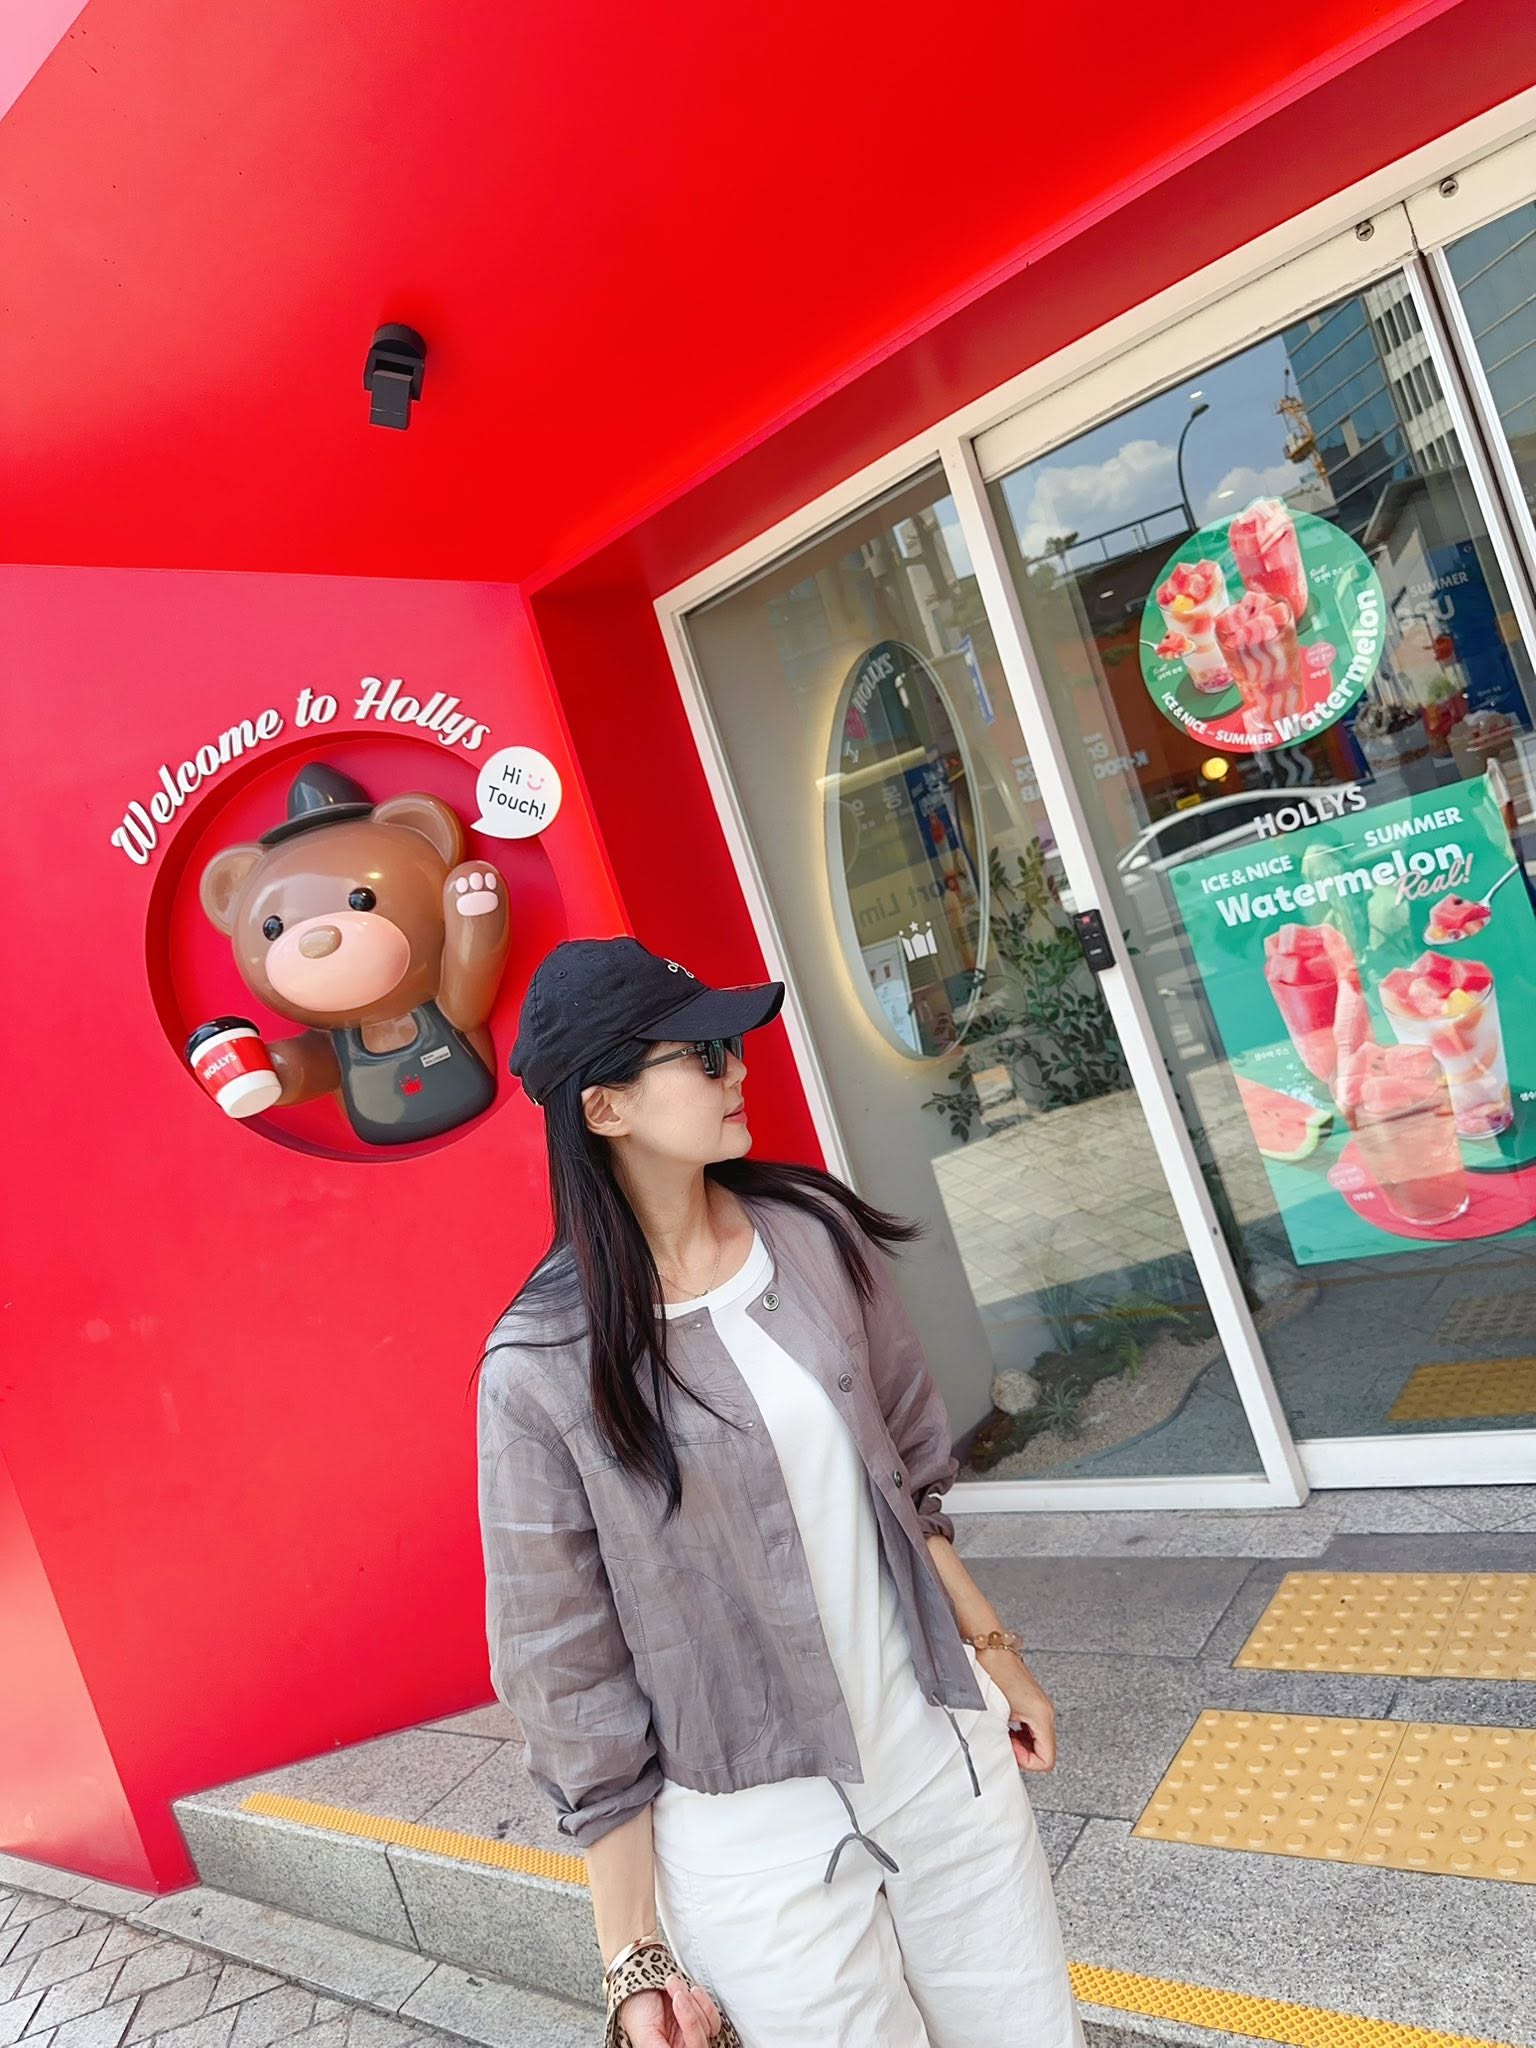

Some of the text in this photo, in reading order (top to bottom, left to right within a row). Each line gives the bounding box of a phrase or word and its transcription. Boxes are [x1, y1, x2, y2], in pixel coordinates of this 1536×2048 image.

[1409, 570, 1470, 598] SUMMER
[1273, 588, 1379, 742] Watermelon
[1215, 730, 1273, 746] SUMMER
[110, 676, 492, 865] Welcome to Hollys
[502, 764, 522, 785] Hi
[488, 785, 546, 820] Touch!
[1253, 786, 1367, 840] HOLLYS
[1364, 807, 1463, 849] SUMMER
[1215, 842, 1465, 928] Watermelon
[1394, 852, 1474, 906] Real!
[203, 1051, 237, 1080] HOLLYS
